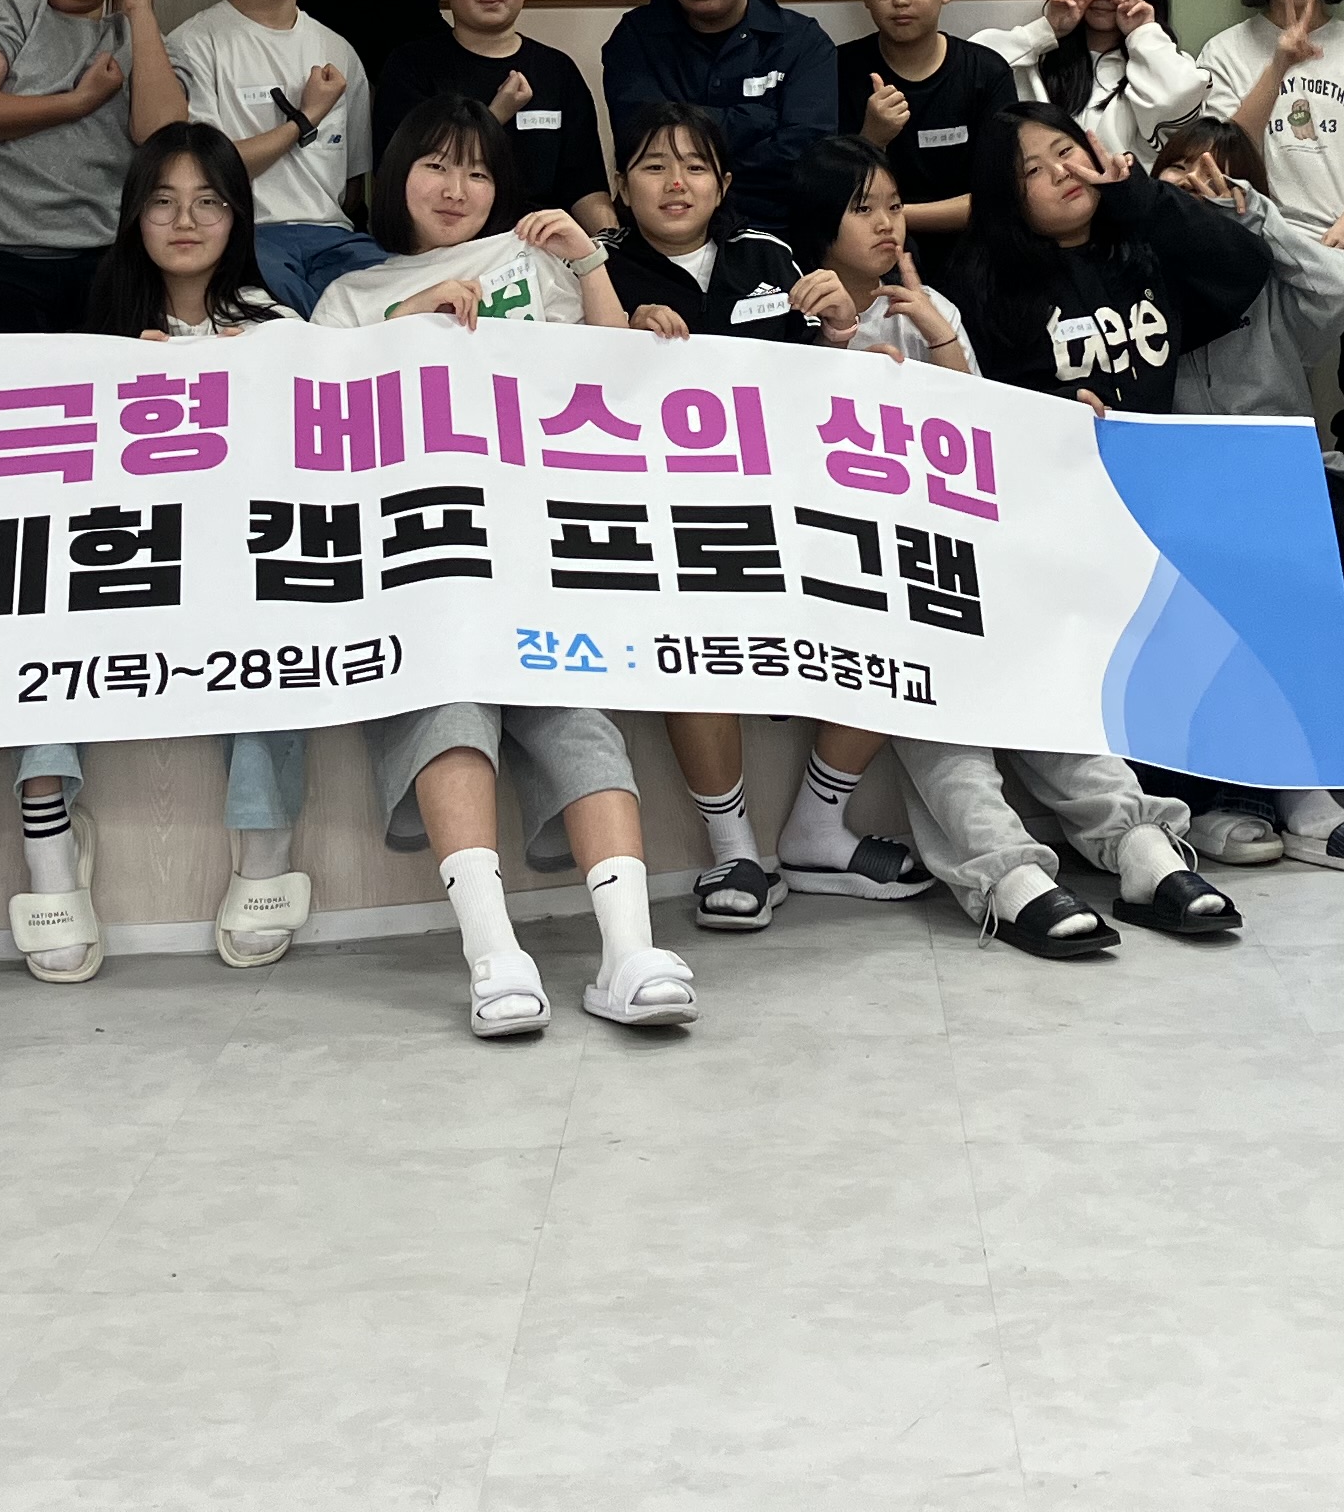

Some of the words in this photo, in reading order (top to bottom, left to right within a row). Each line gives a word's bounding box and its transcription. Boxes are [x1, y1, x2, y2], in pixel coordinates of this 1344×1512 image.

[1278, 76, 1296, 96] AY
[1320, 119, 1338, 133] 43
[295, 366, 770, 475] 베니스의
[818, 397, 998, 521] 상인
[247, 486, 492, 603] 캠프
[547, 498, 984, 637] 프로그램
[18, 634, 402, 703] 27(목)~28일(금)
[516, 628, 608, 673] 장소
[654, 634, 937, 706] 하동중앙중학교
[243, 901, 291, 911] GEOGRAPHIC
[247, 894, 287, 905] NATIONAL
[27, 917, 75, 927] GEOGRAPHIC
[31, 910, 69, 919] NATIONAL
